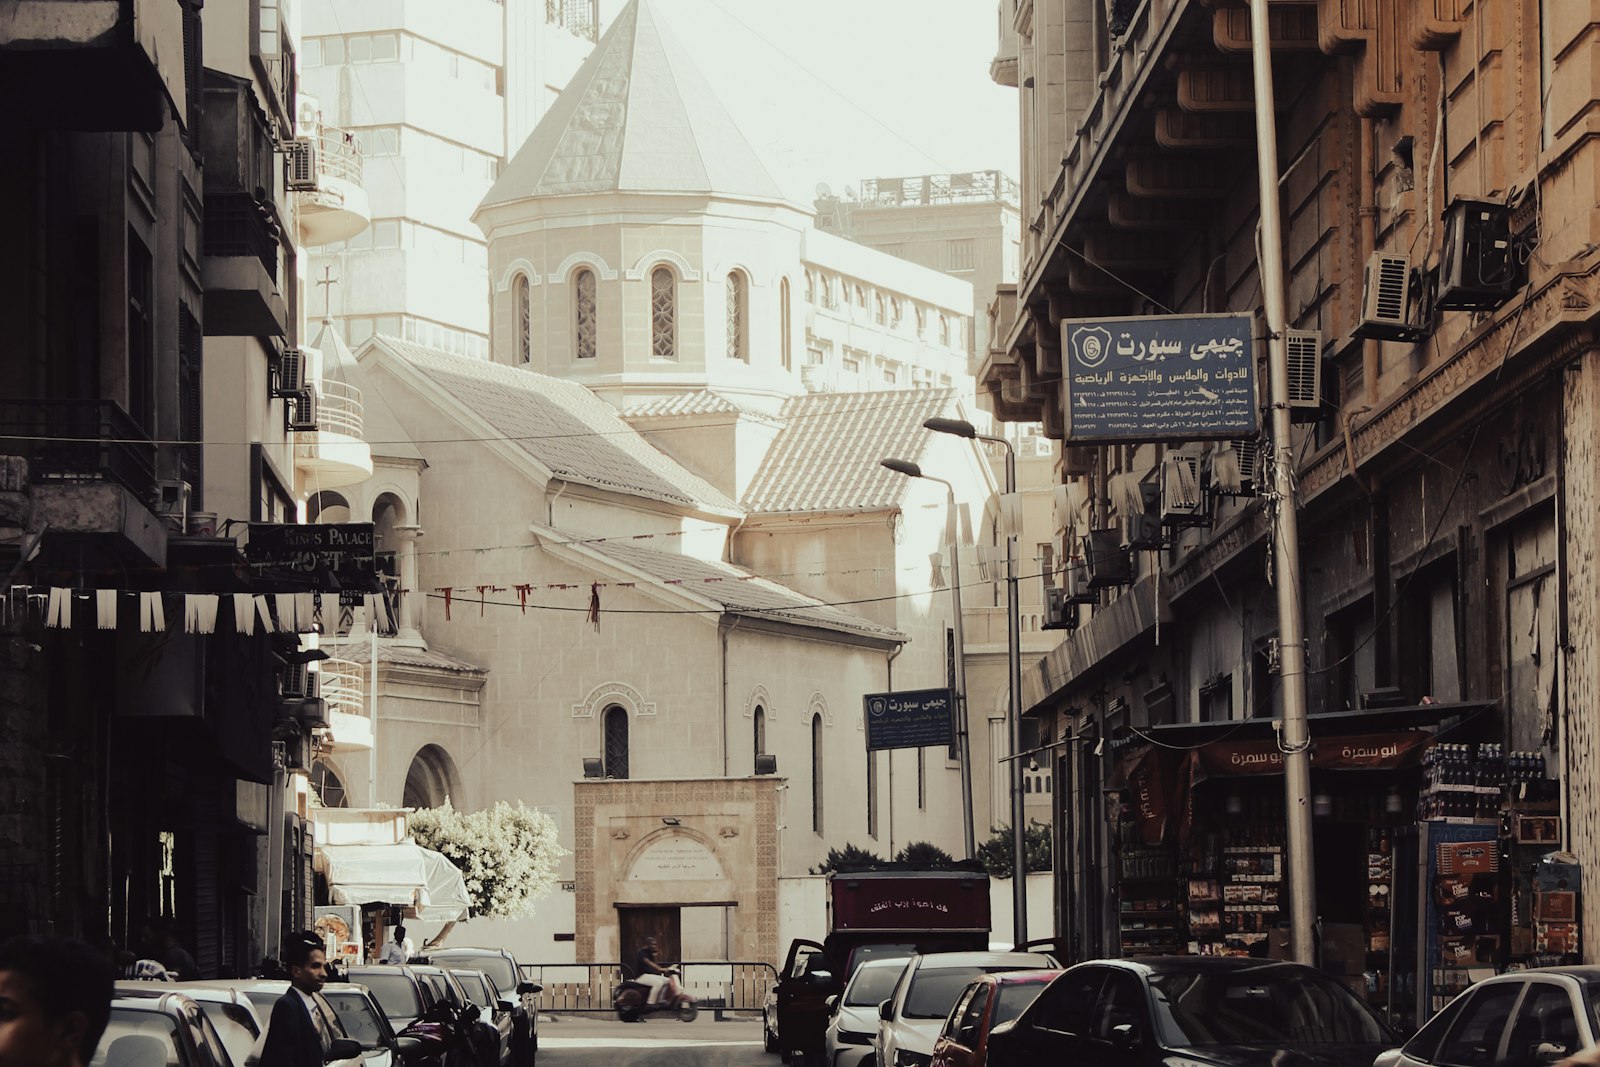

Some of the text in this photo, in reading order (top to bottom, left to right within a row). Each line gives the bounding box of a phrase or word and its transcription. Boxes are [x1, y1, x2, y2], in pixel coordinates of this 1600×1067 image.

[1116, 332, 1182, 362] سبورت
[1074, 370, 1112, 384] الرياضية
[1168, 368, 1208, 382] والملابس
[1201, 409, 1214, 417] شارع
[328, 528, 372, 545] PALACE
[889, 700, 918, 712] سبورت
[1342, 742, 1397, 759] أبو سمرة
[1232, 753, 1284, 766] بو سمرة
